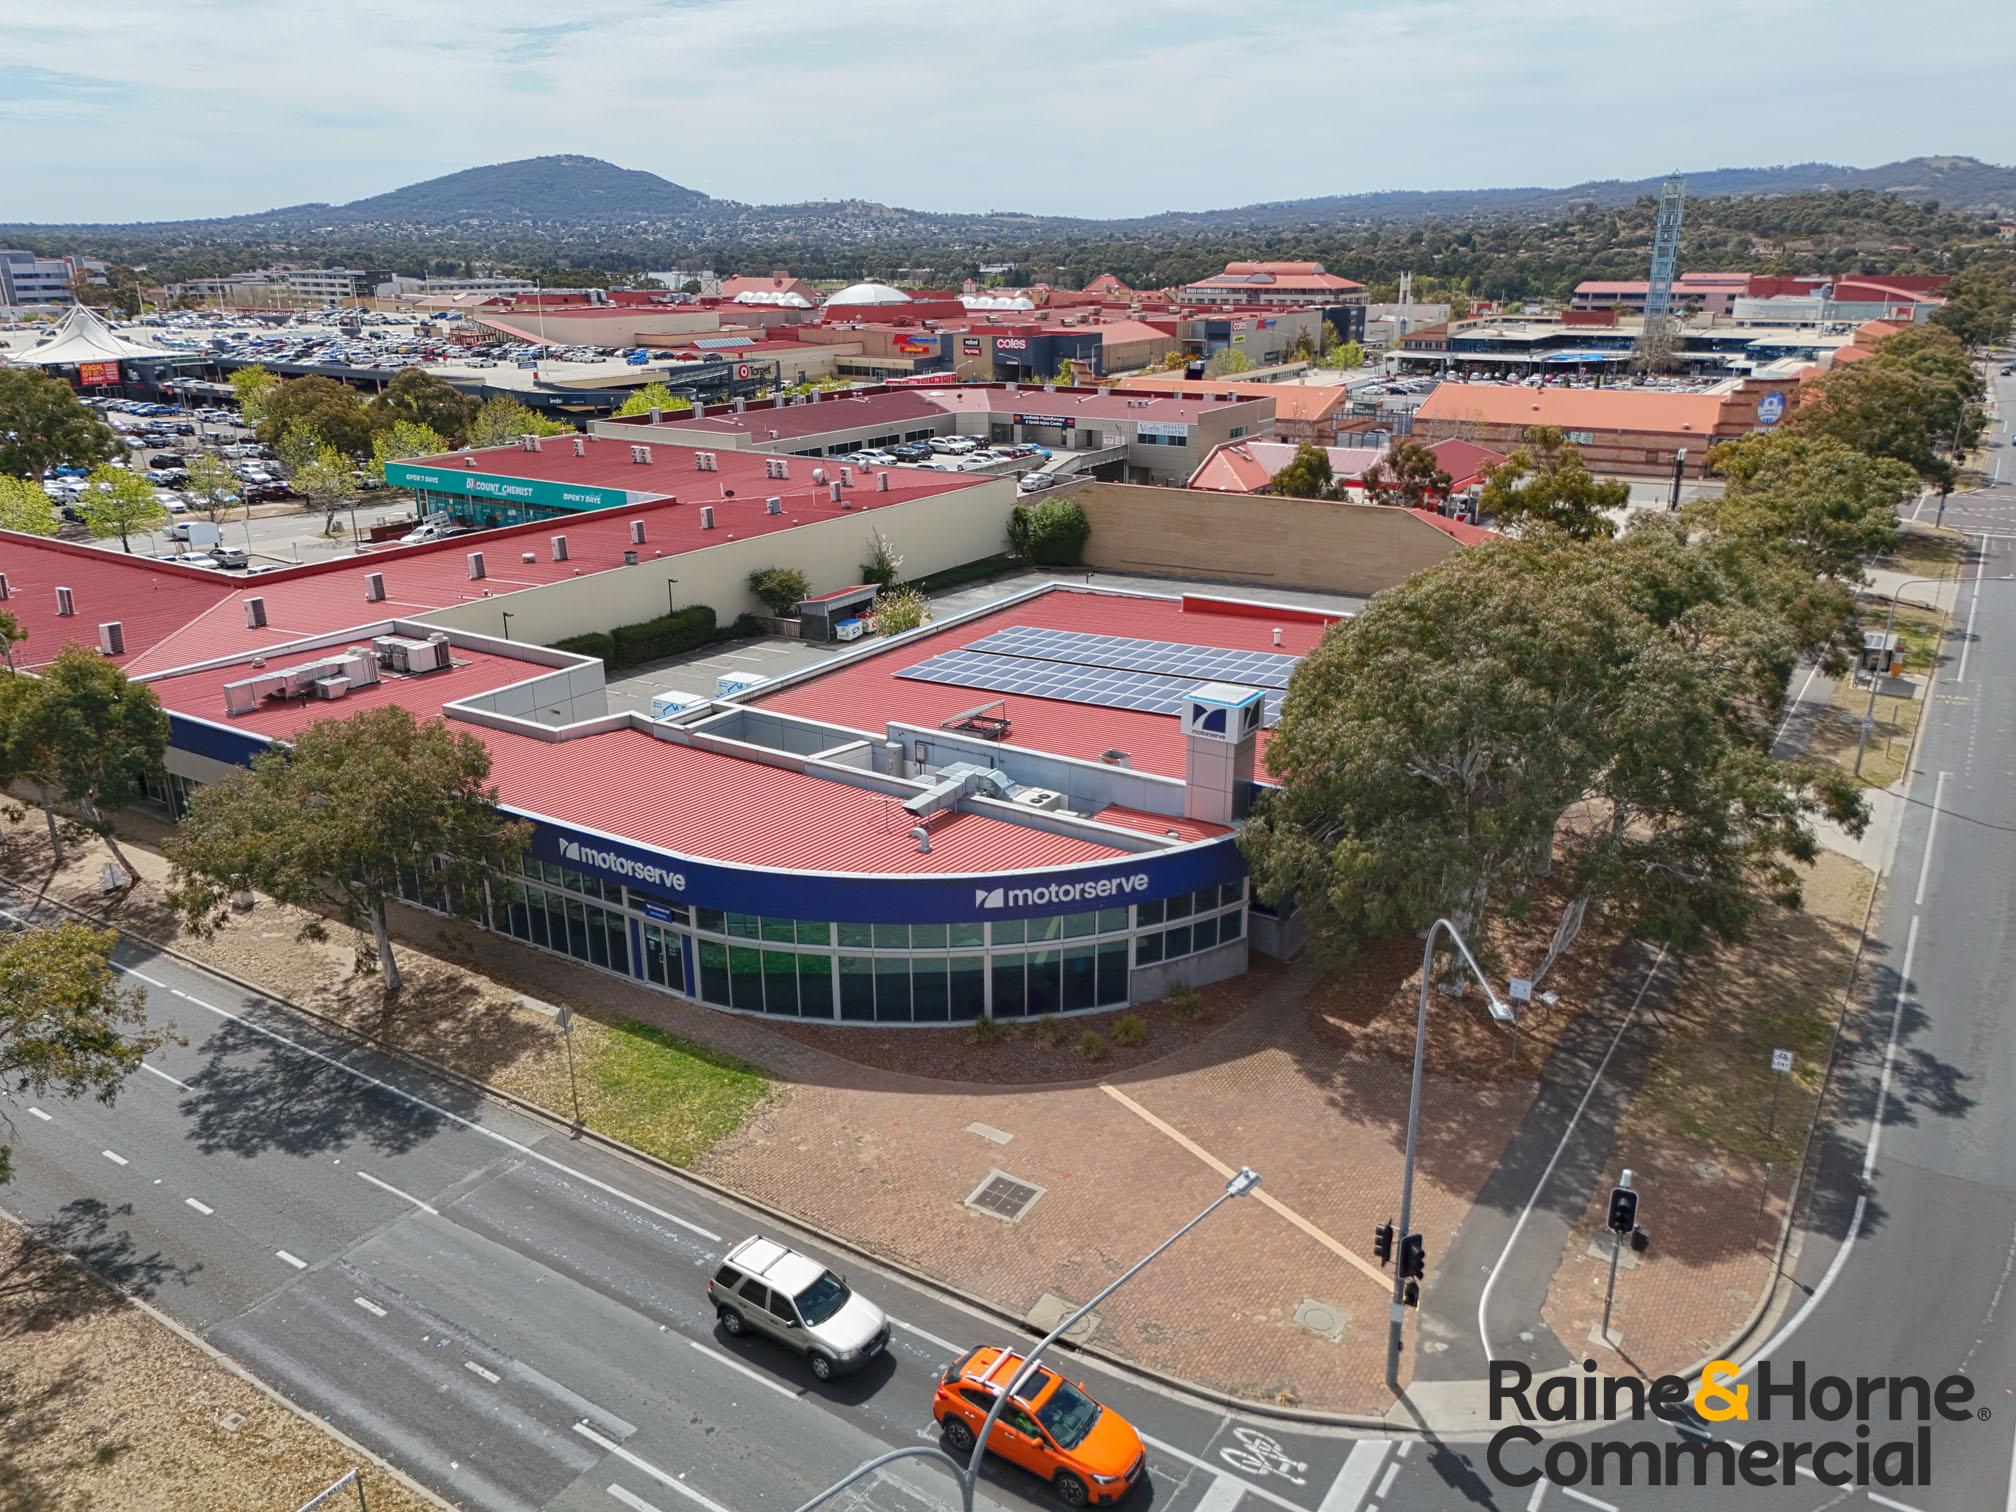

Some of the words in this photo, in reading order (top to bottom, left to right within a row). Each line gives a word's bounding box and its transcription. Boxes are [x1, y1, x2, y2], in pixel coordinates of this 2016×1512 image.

[997, 338, 1026, 349] coles
[749, 365, 772, 377] Target
[425, 476, 439, 484] DAYS
[502, 485, 533, 497] CHEMIST
[563, 493, 580, 502] OPEN
[585, 496, 601, 504] DAYS
[1192, 729, 1226, 740] motorserve
[580, 846, 686, 892] motorserve
[1008, 873, 1149, 907] motorserve
